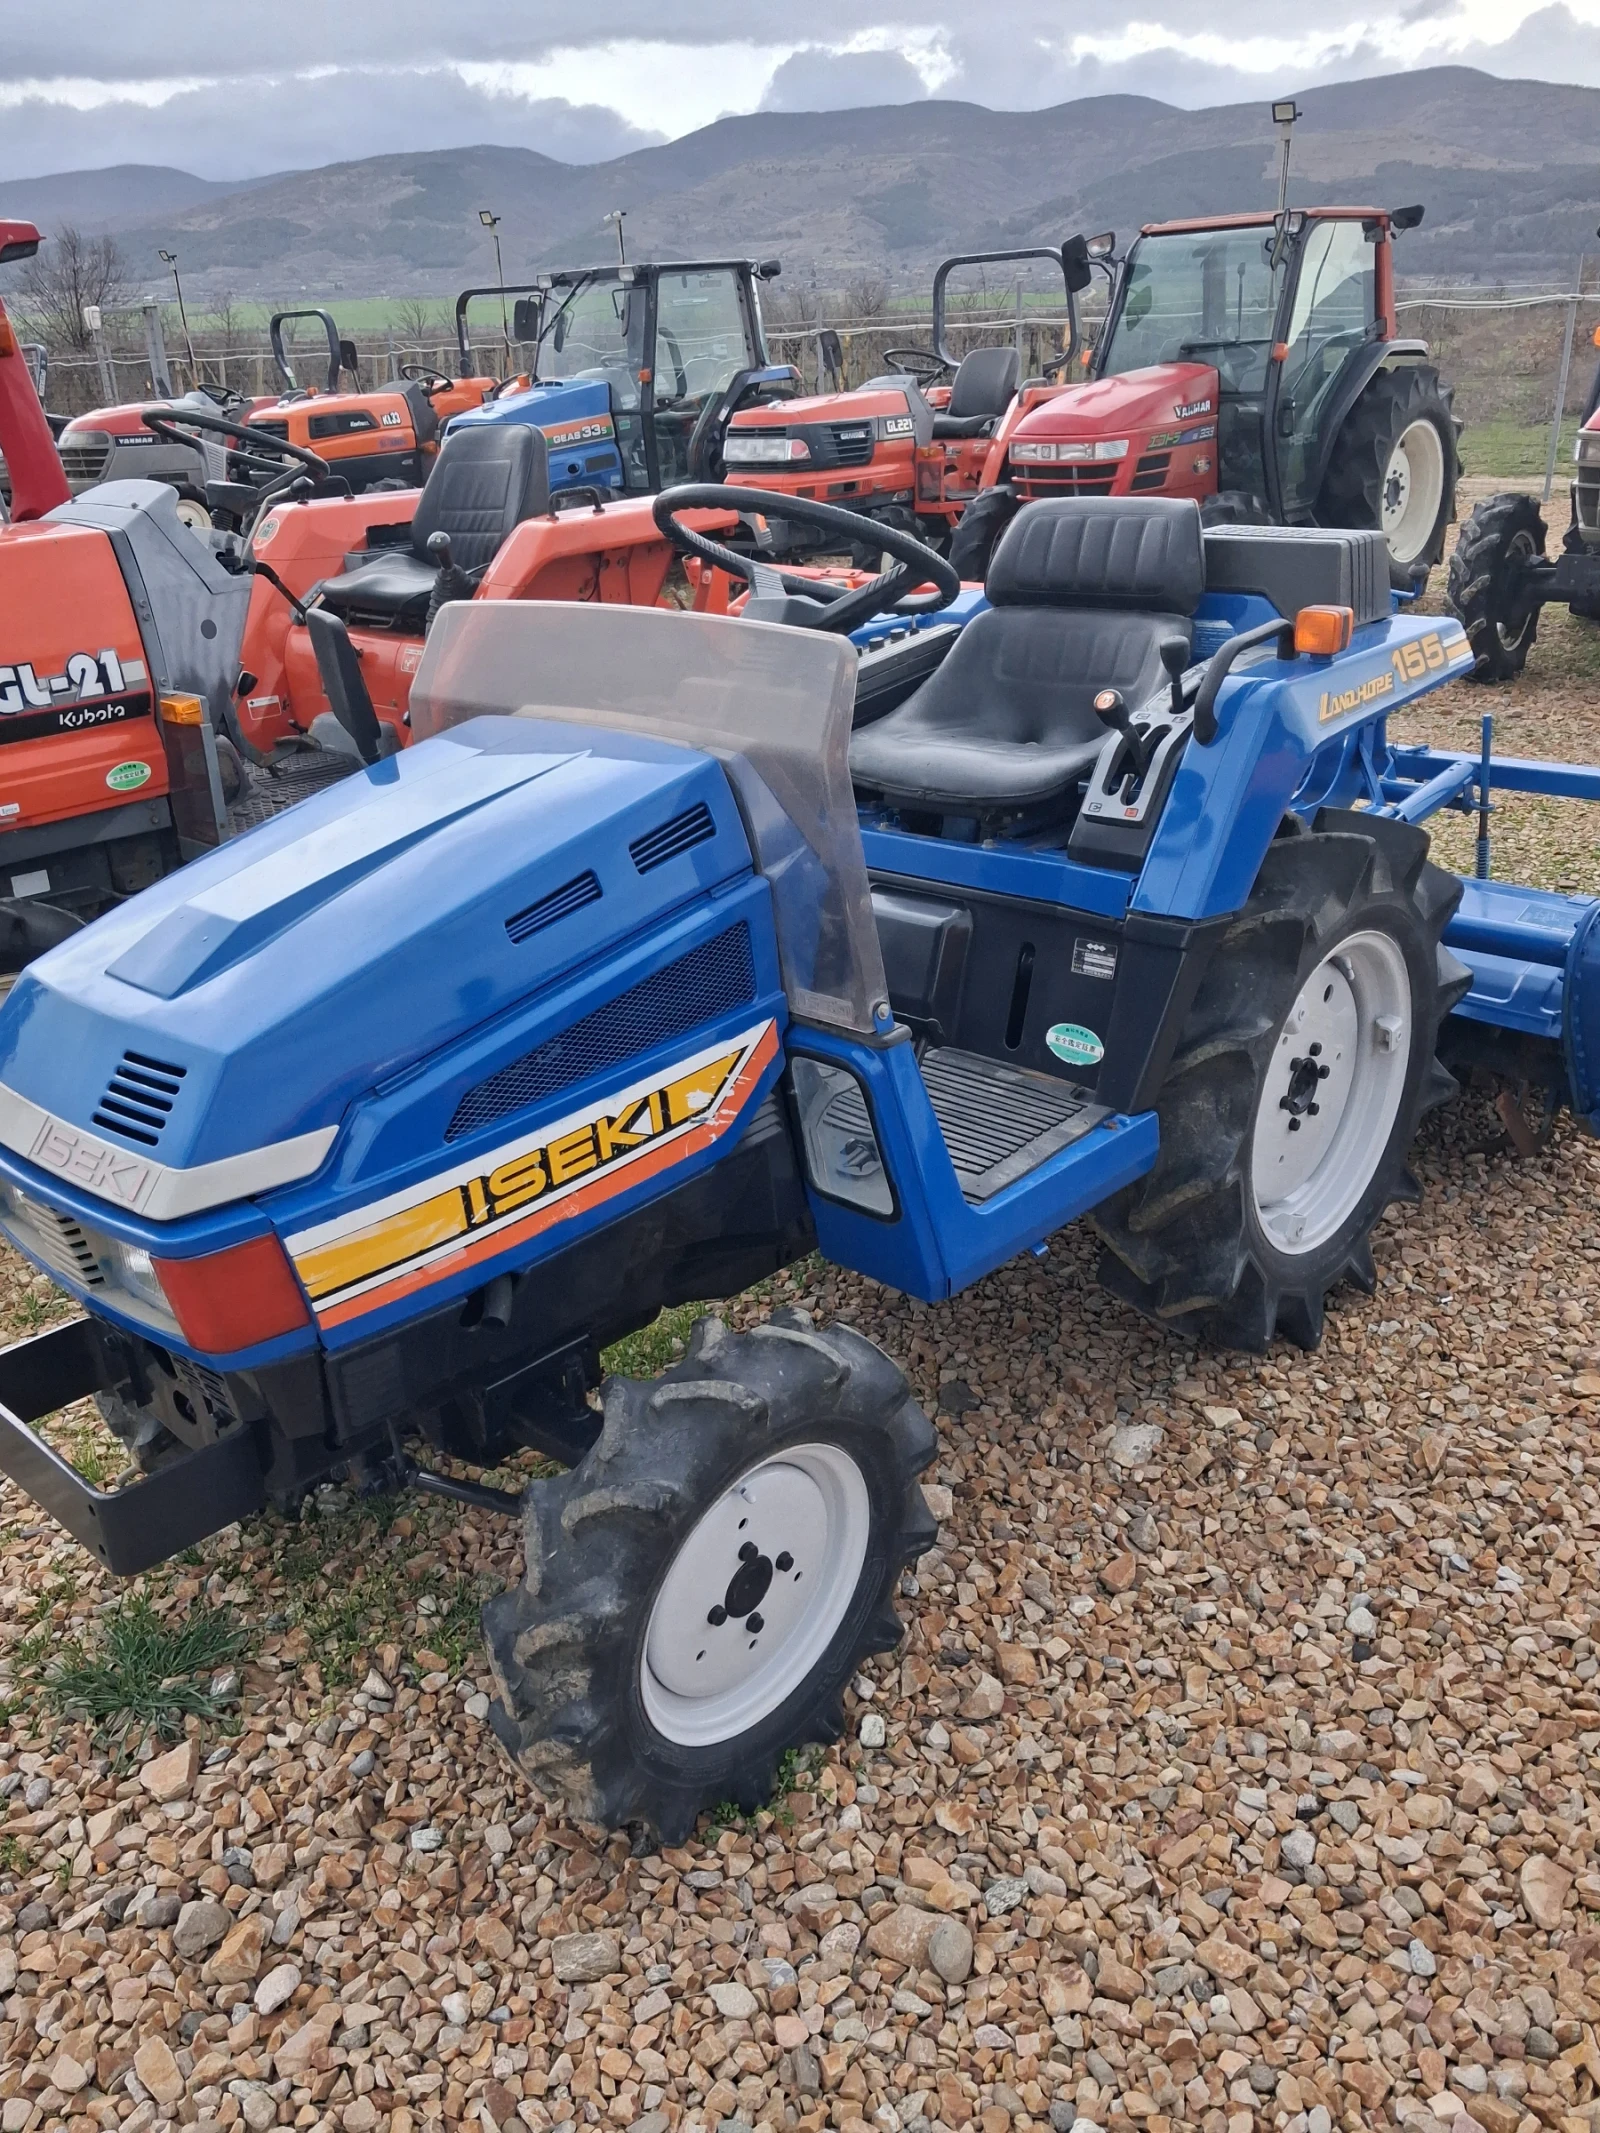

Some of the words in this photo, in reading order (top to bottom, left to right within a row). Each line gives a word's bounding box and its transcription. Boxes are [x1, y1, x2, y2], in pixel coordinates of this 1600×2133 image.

[382, 411, 401, 425] KL33
[886, 418, 913, 432] GL221
[1174, 399, 1211, 418] YANMAR
[1391, 632, 1445, 683] 155
[0, 650, 126, 713] GL-21
[59, 703, 125, 727] Kubota
[33, 1123, 149, 1203] ISEKI
[467, 1091, 665, 1225] ISEKI
